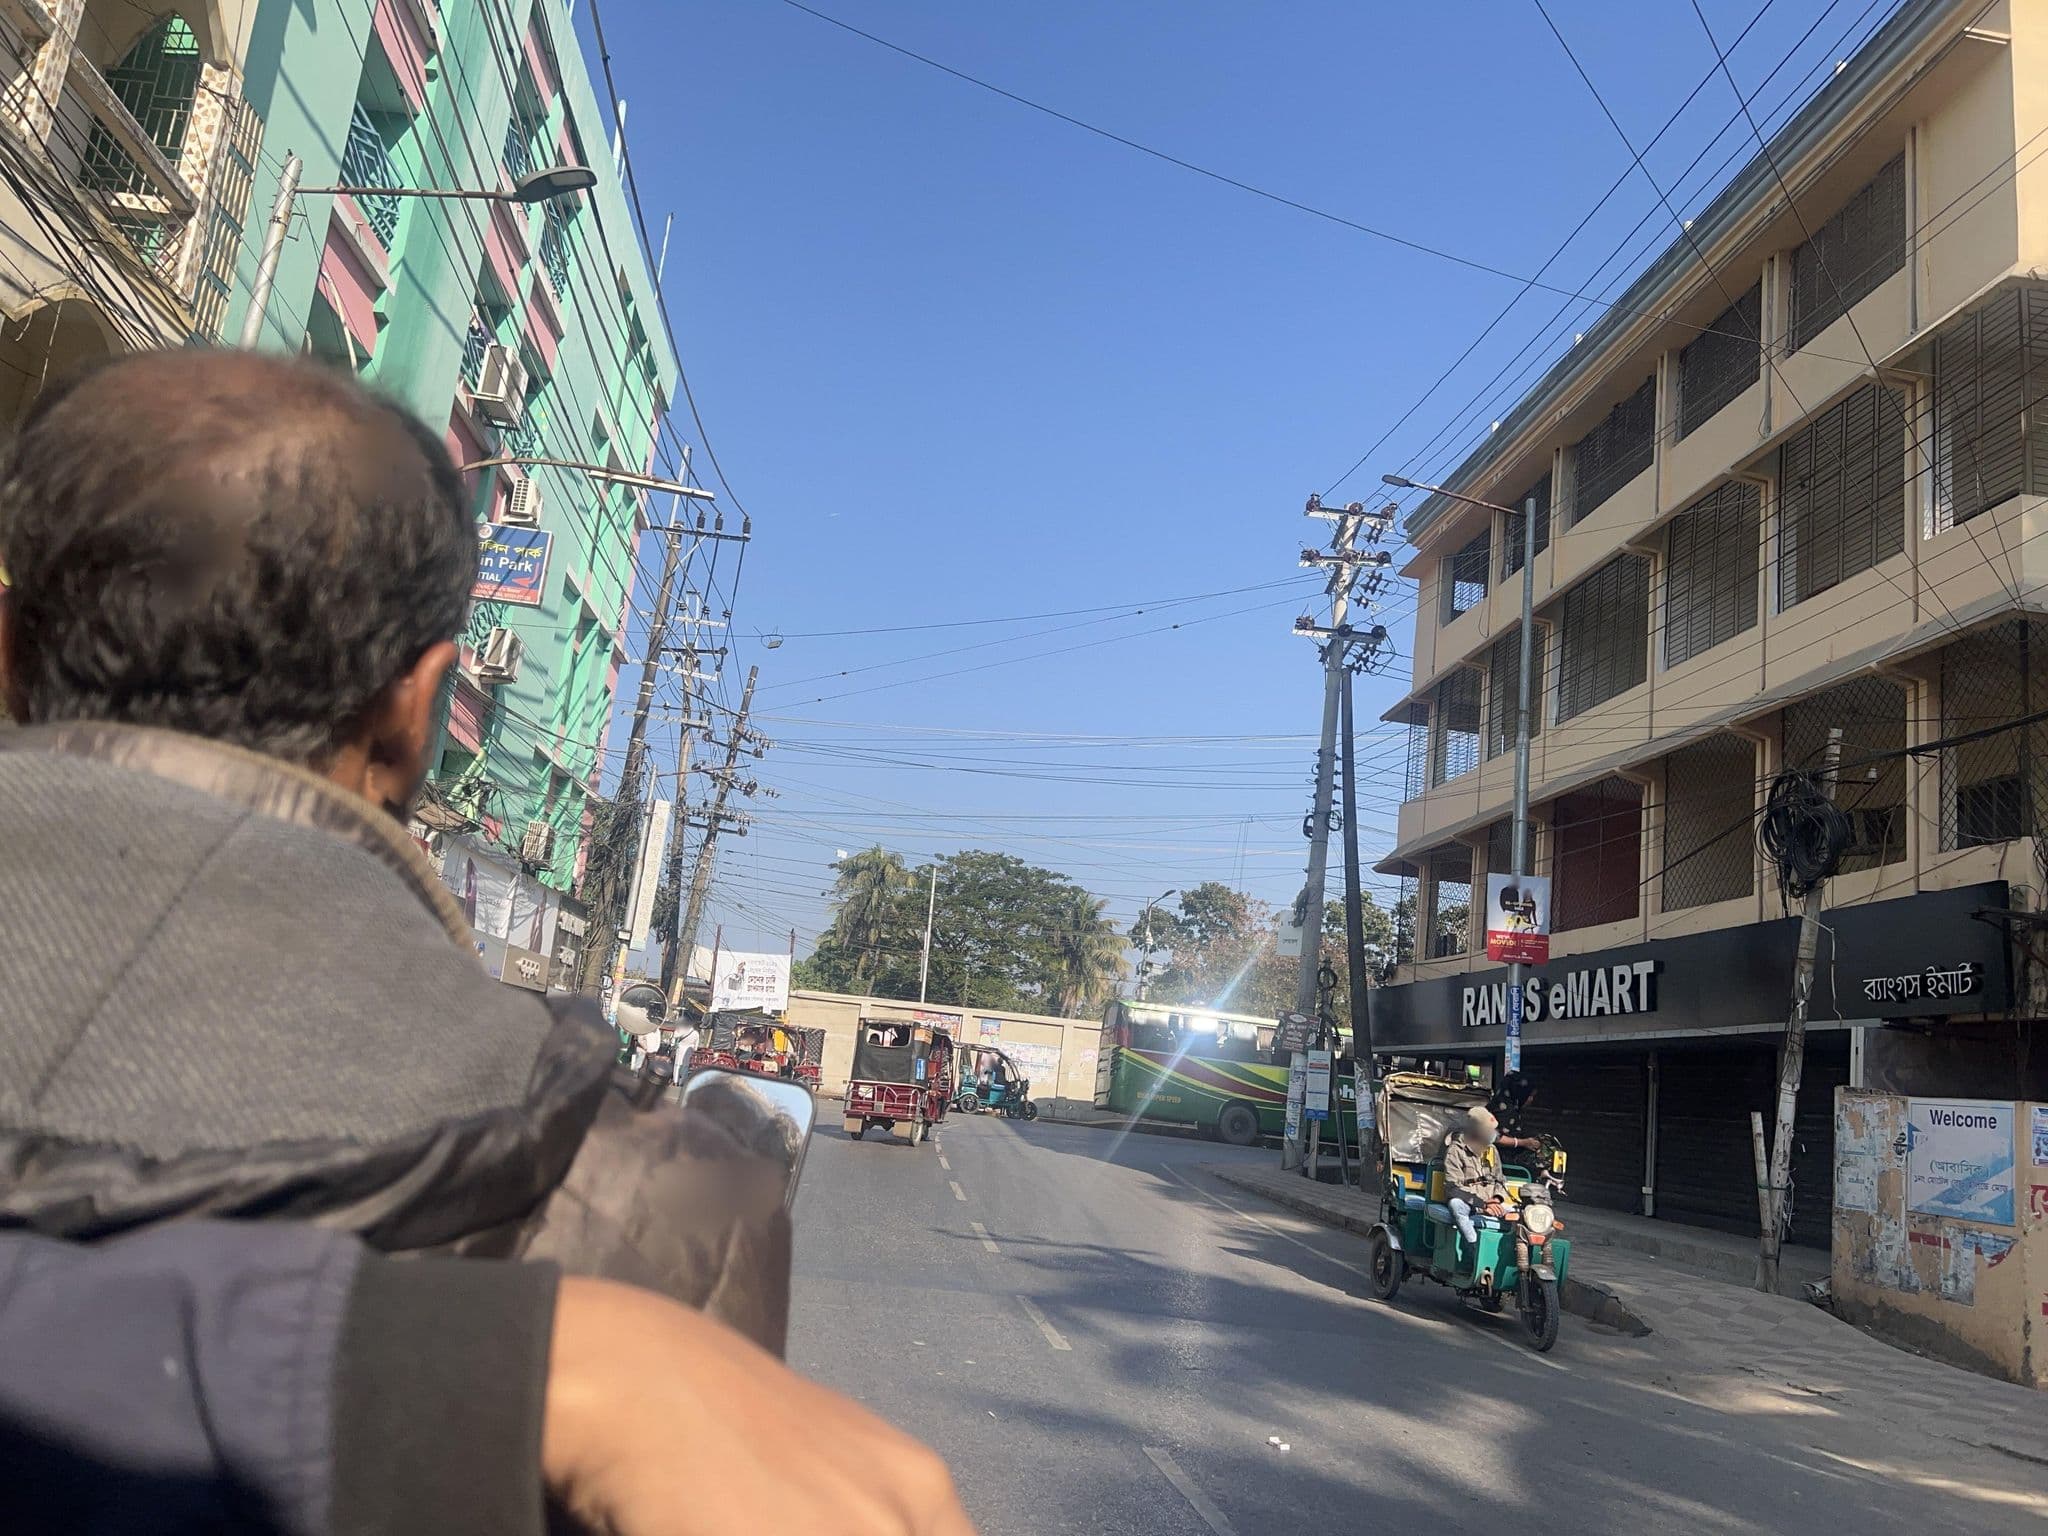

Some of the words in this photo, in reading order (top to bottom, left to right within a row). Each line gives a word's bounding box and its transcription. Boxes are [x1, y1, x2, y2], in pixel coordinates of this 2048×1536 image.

[514, 546, 543, 558] পার্ক
[499, 556, 533, 573] Park
[1925, 962, 1973, 998] ইমার্ট
[1462, 977, 1541, 1027] RANS
[1550, 960, 1655, 1020] eMART
[1930, 1109, 1997, 1130] Welcome
